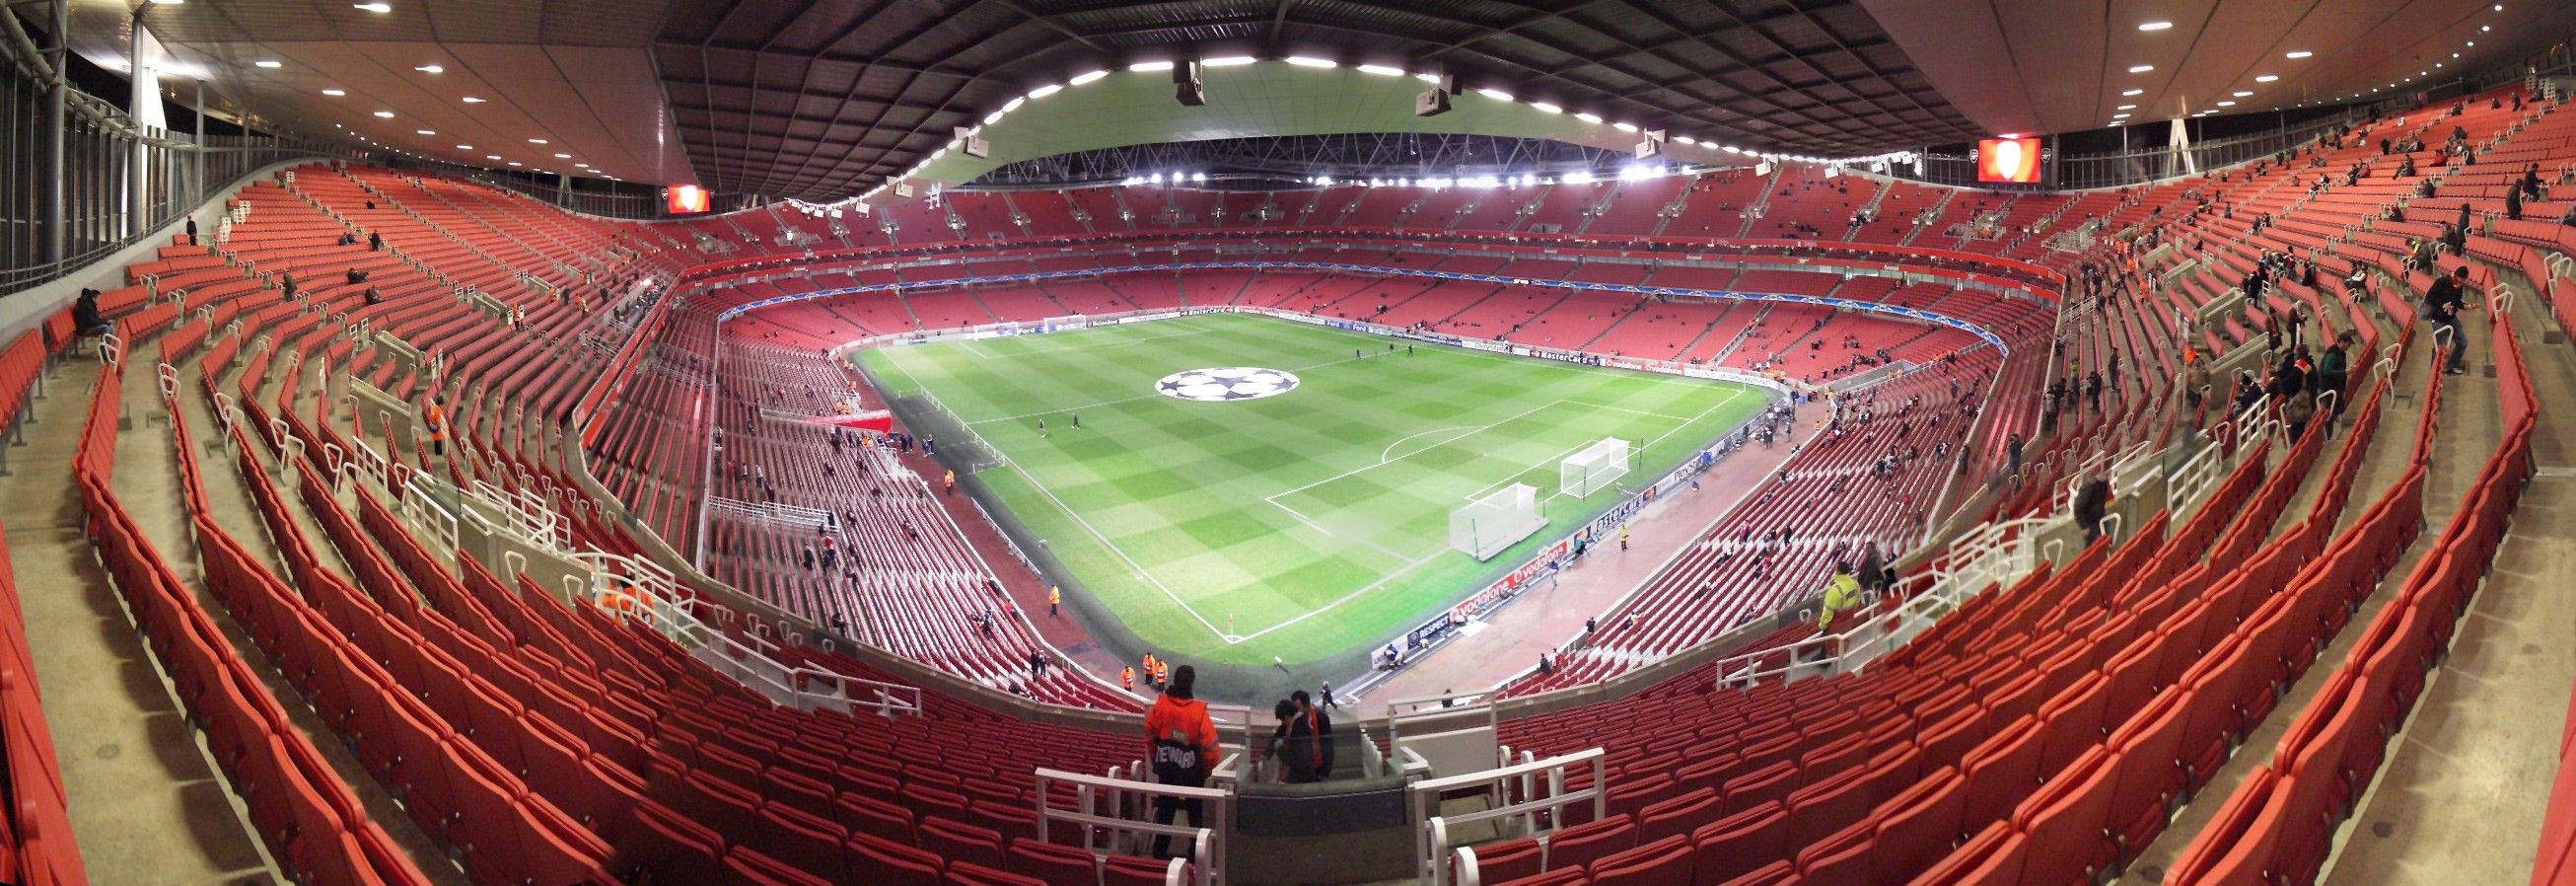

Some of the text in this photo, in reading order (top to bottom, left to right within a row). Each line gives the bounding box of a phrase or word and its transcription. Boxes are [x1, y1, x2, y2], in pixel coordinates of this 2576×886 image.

[1352, 324, 1367, 332] Ford
[1540, 351, 1588, 364] MasterCard
[1420, 616, 1450, 639] RESPECT
